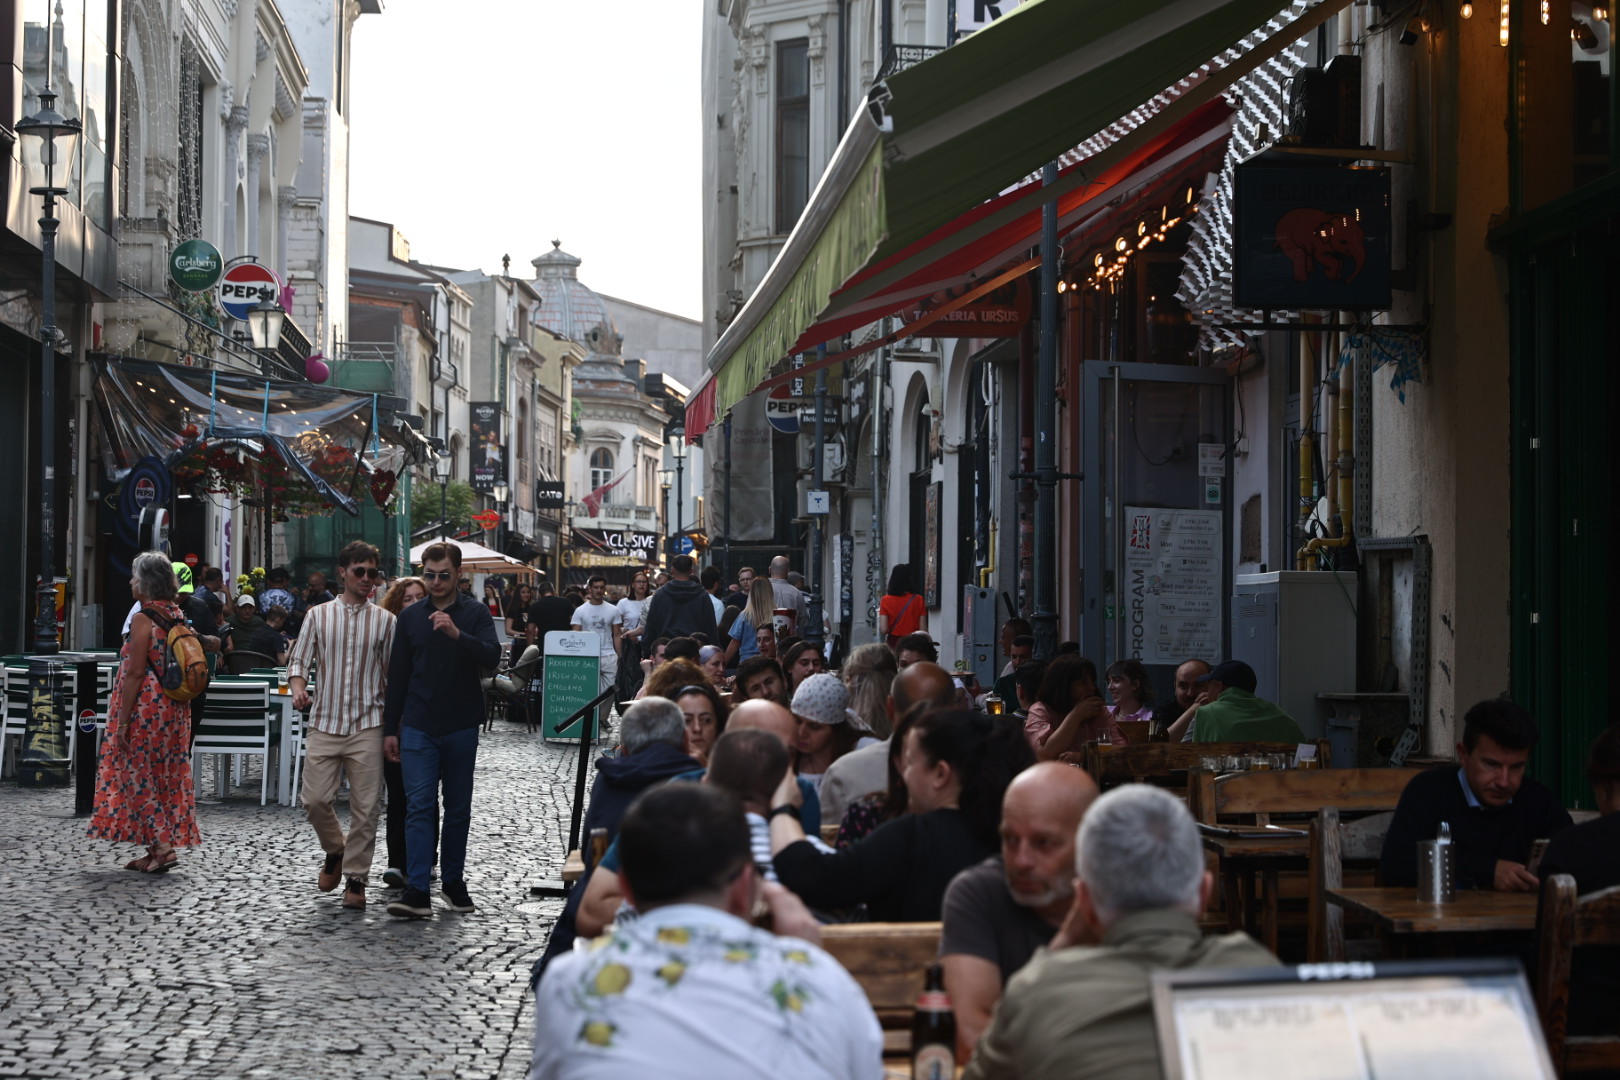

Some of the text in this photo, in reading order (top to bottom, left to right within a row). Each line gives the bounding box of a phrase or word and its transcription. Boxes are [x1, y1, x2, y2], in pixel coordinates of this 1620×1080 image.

[175, 256, 216, 272] Carlsberg
[981, 309, 1019, 322] URSUS
[136, 489, 153, 497] PEPSI
[1132, 569, 1144, 661] PROGRAM
[559, 639, 586, 648] Carlsberg
[574, 673, 587, 681] PUB
[547, 682, 583, 692] ENGLAND
